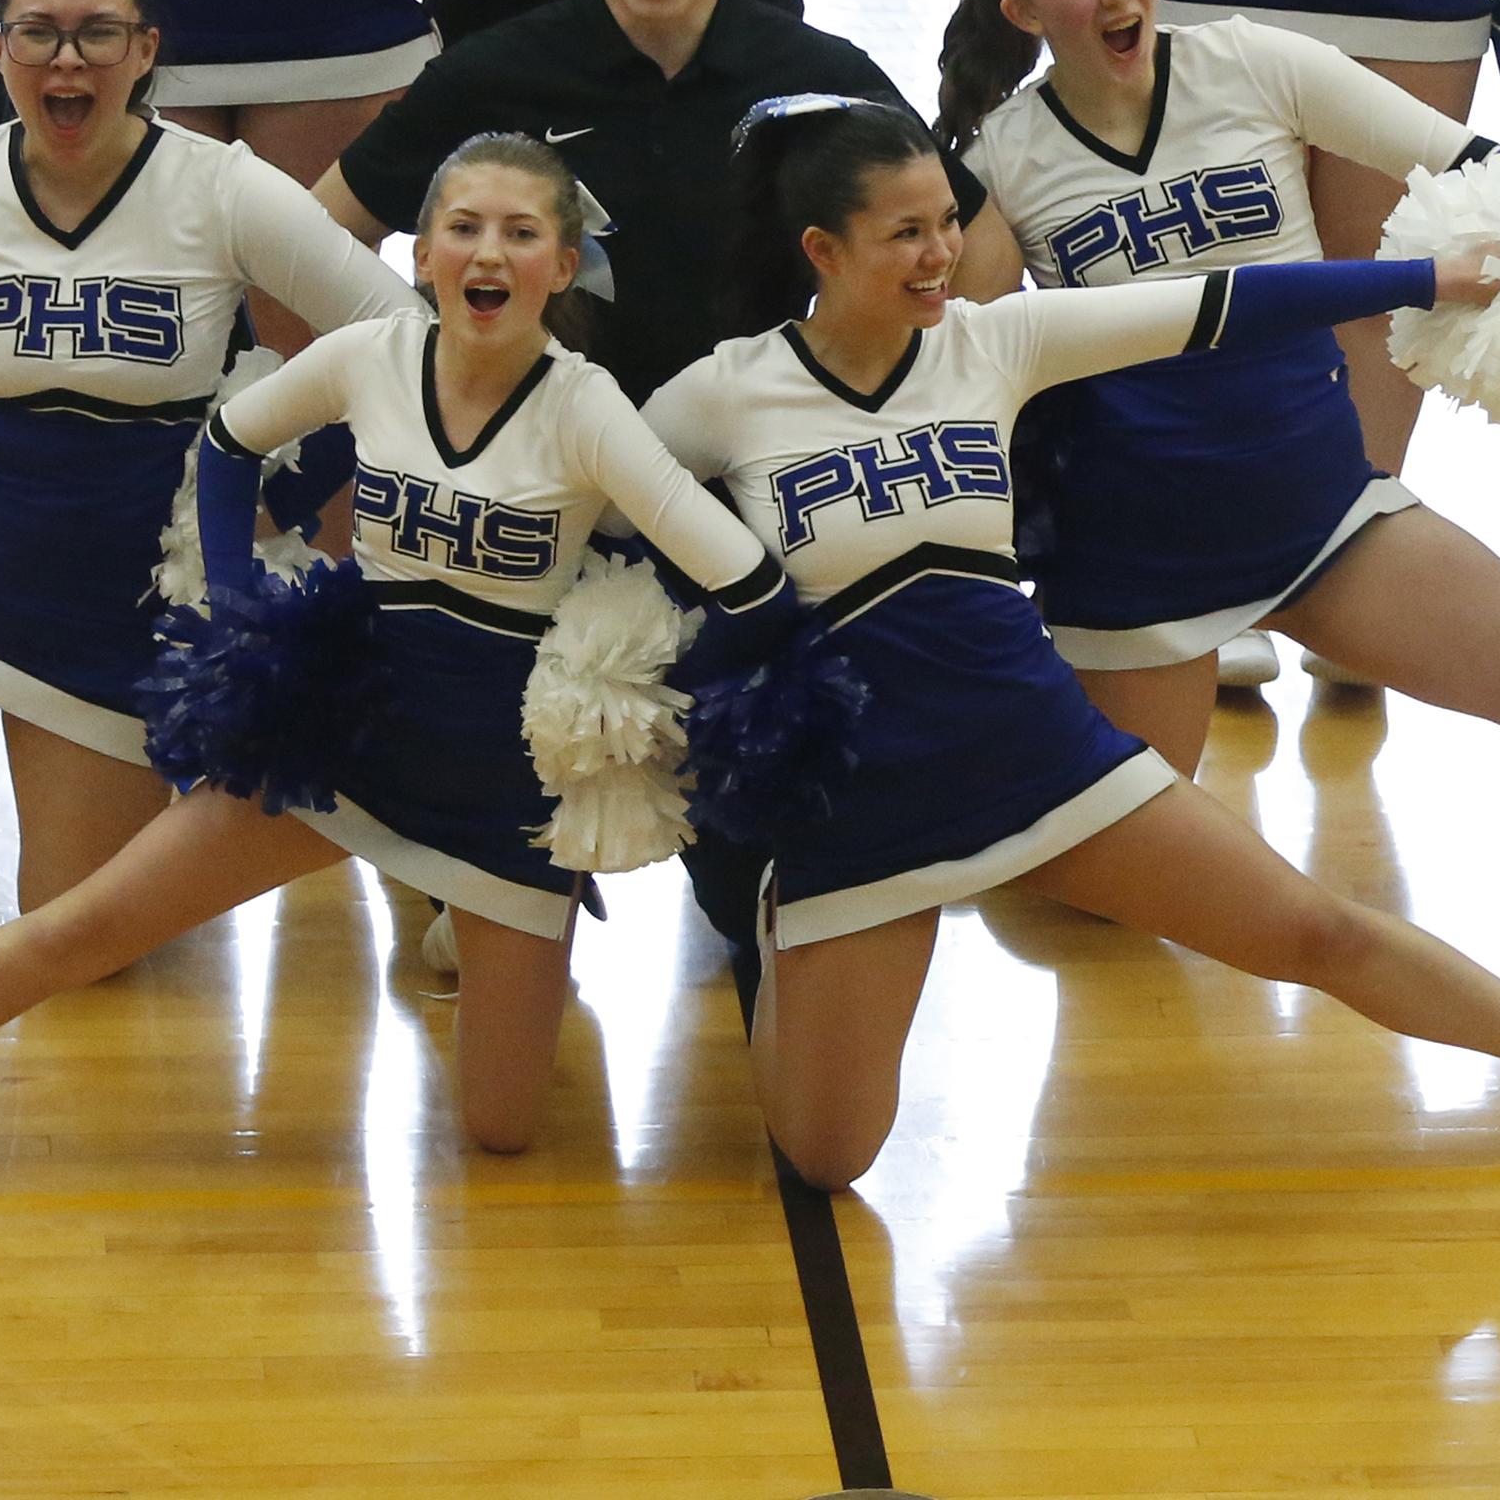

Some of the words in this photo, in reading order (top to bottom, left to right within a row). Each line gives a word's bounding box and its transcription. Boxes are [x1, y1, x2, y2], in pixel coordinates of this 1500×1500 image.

[1044, 158, 1285, 288] PHS
[351, 459, 561, 582] PHS
[768, 420, 1013, 558] PHS
